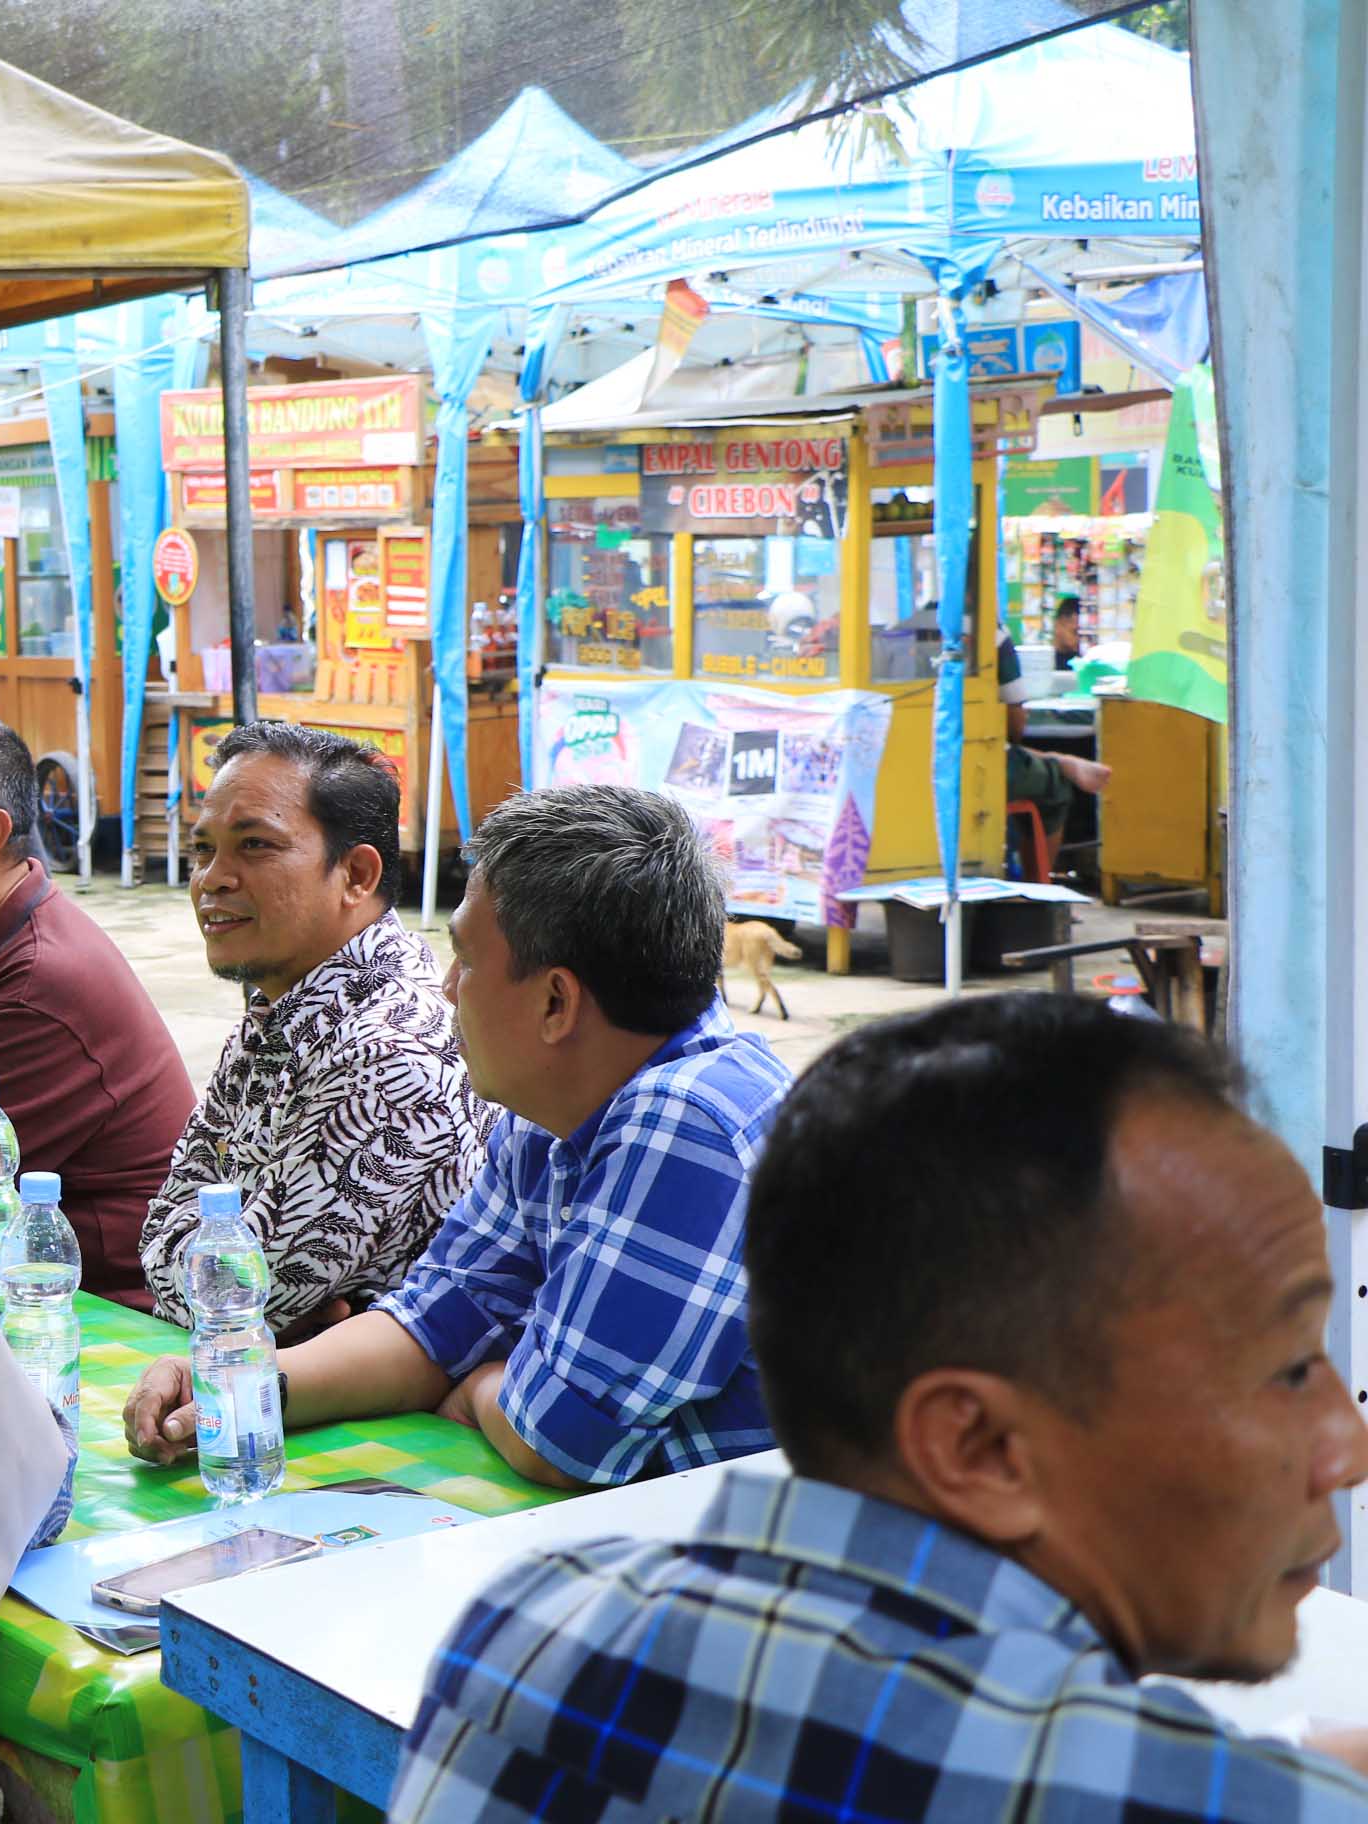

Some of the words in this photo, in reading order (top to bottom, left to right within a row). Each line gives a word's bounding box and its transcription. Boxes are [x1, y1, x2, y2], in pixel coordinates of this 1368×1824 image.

[1042, 193, 1154, 220] Kebaikan
[671, 227, 741, 262] Mineral
[173, 400, 257, 436] KULIR
[258, 395, 358, 433] BANDUNG
[643, 442, 715, 474] EMPAL
[725, 438, 842, 471] GENTONG
[733, 747, 777, 780] 1M
